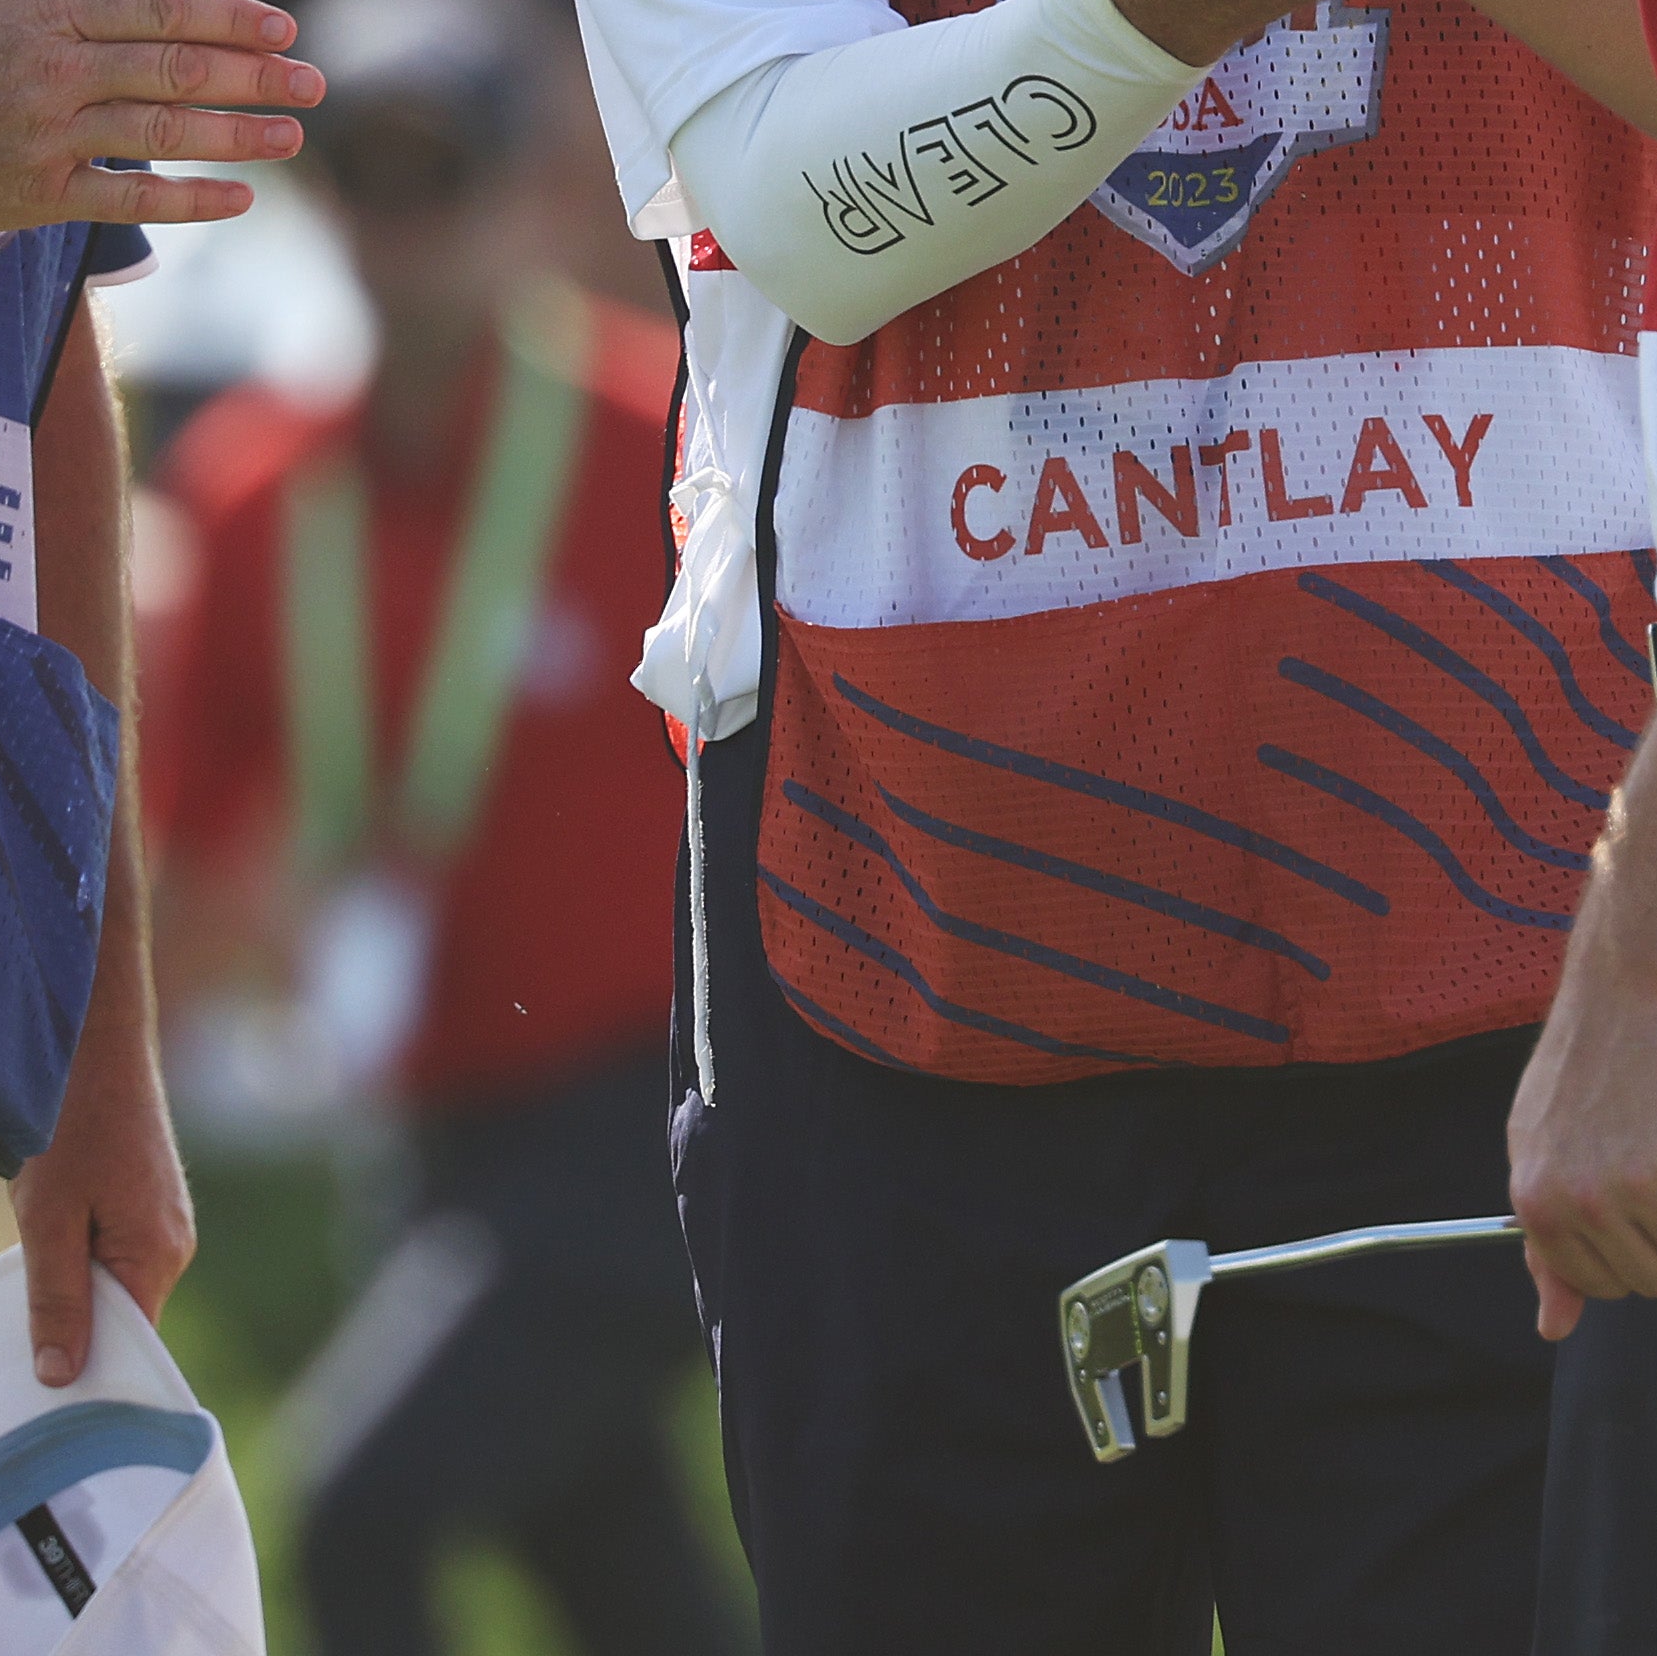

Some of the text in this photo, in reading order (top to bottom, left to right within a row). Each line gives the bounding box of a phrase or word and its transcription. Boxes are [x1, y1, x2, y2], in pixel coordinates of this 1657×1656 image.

[802, 74, 1097, 255] CLEAR
[1148, 167, 1239, 207] 2023
[950, 413, 1494, 562] CANTLAY
